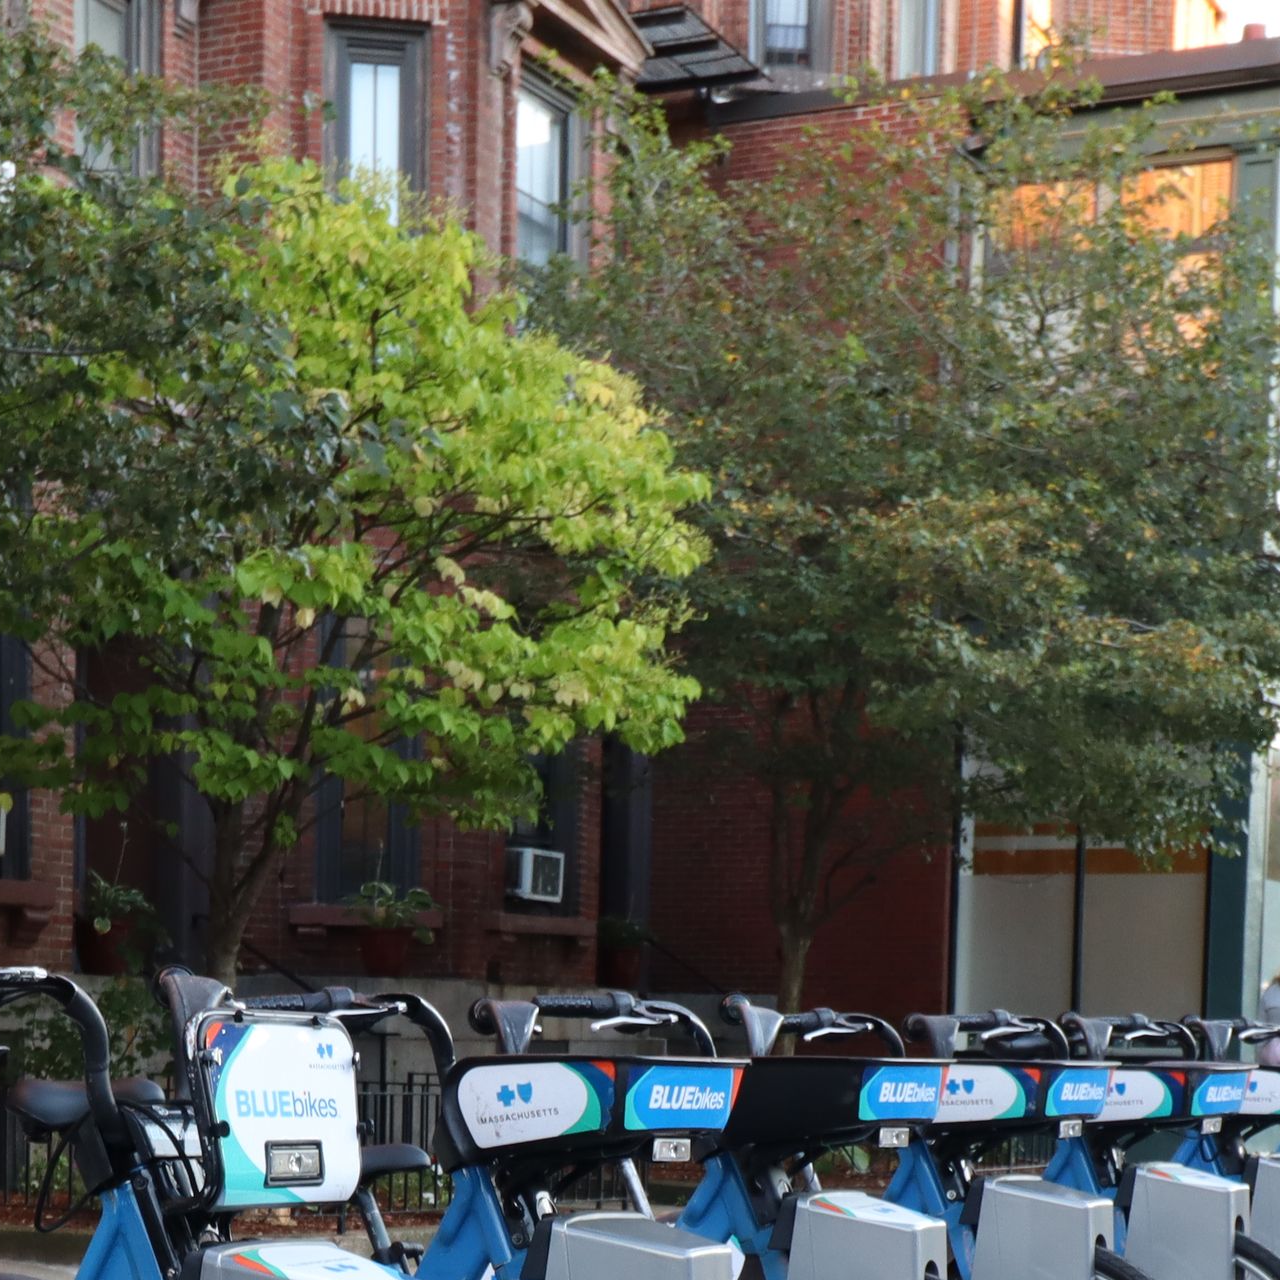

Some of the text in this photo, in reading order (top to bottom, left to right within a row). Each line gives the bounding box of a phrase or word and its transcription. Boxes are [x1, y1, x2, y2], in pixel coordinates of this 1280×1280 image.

[235, 1088, 339, 1119] BLUEbikes
[649, 1084, 726, 1110] BLUEbikes
[879, 1082, 936, 1104] BLUEbikes
[480, 1107, 559, 1125] MASSACHUSETTS
